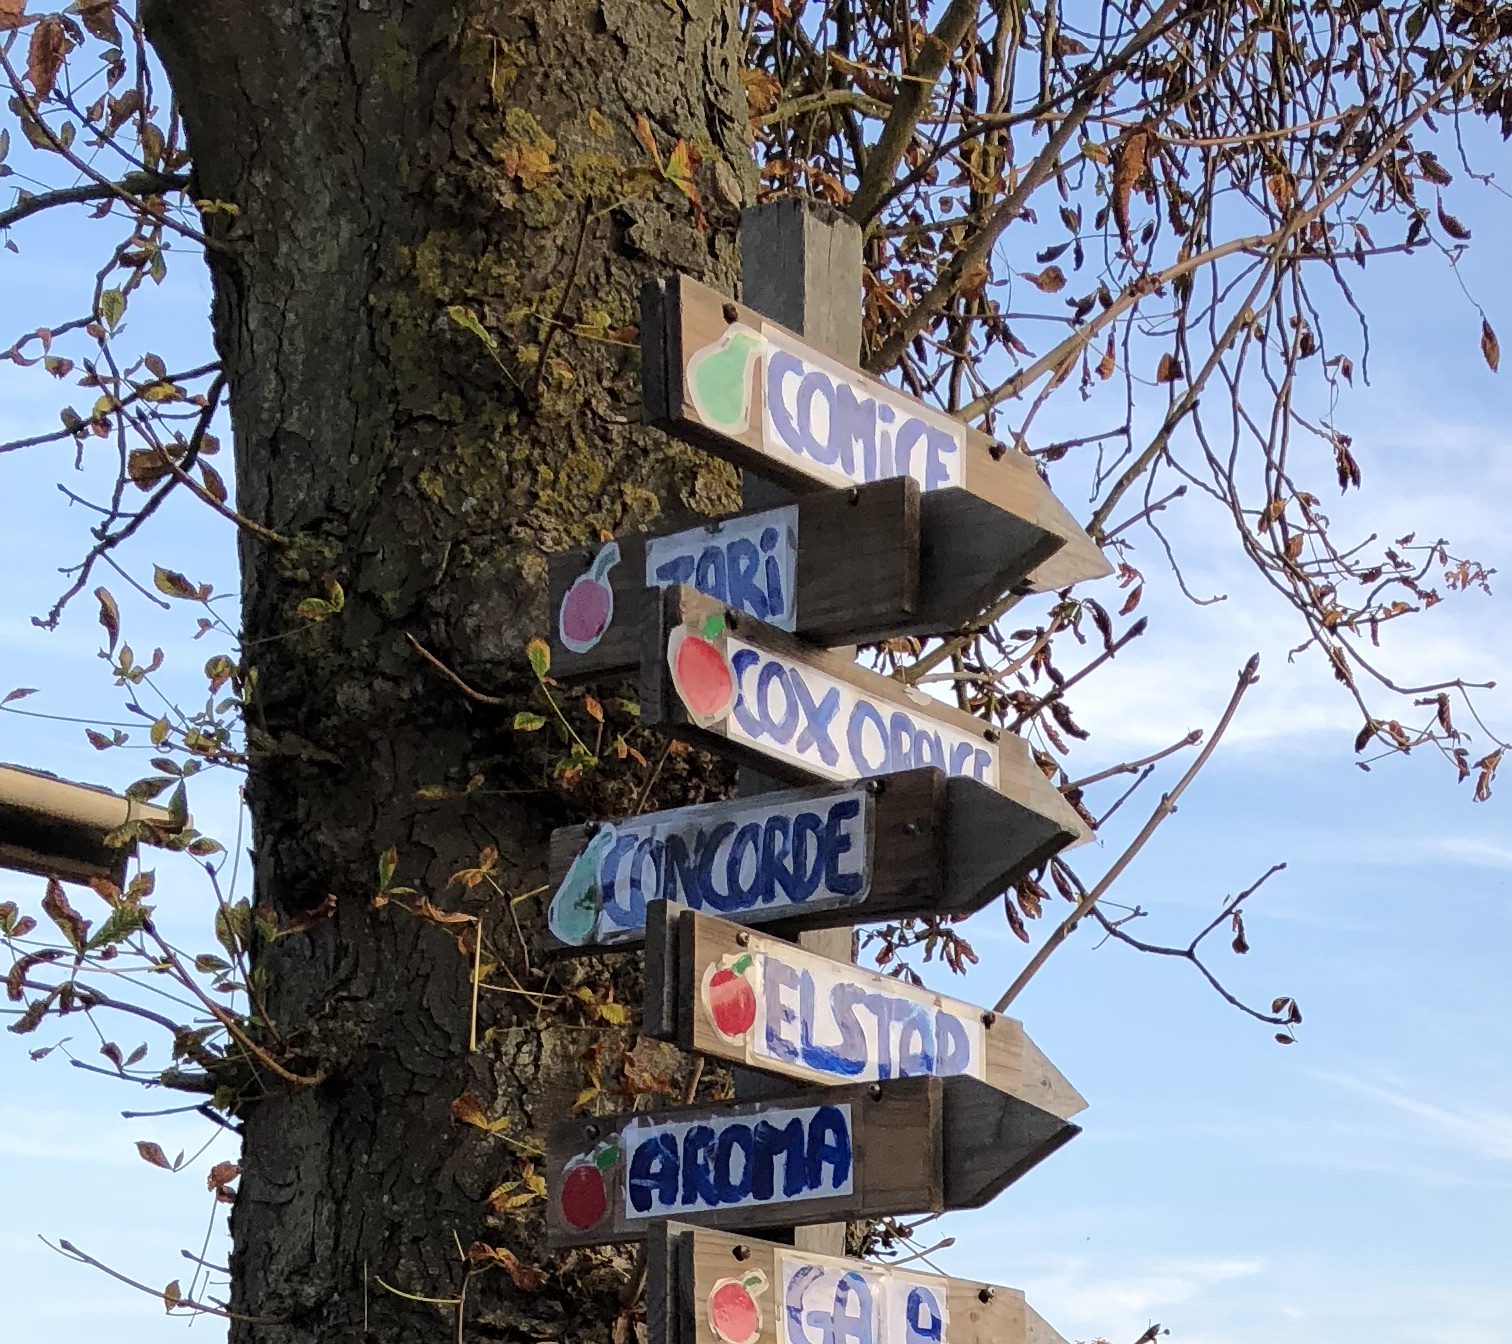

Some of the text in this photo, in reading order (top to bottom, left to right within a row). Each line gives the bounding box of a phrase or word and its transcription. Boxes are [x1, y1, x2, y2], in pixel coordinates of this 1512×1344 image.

[767, 350, 957, 489] COMiCE
[731, 649, 839, 766] COX
[599, 799, 863, 928] CONCORDE
[629, 1106, 850, 1211] AROMA
